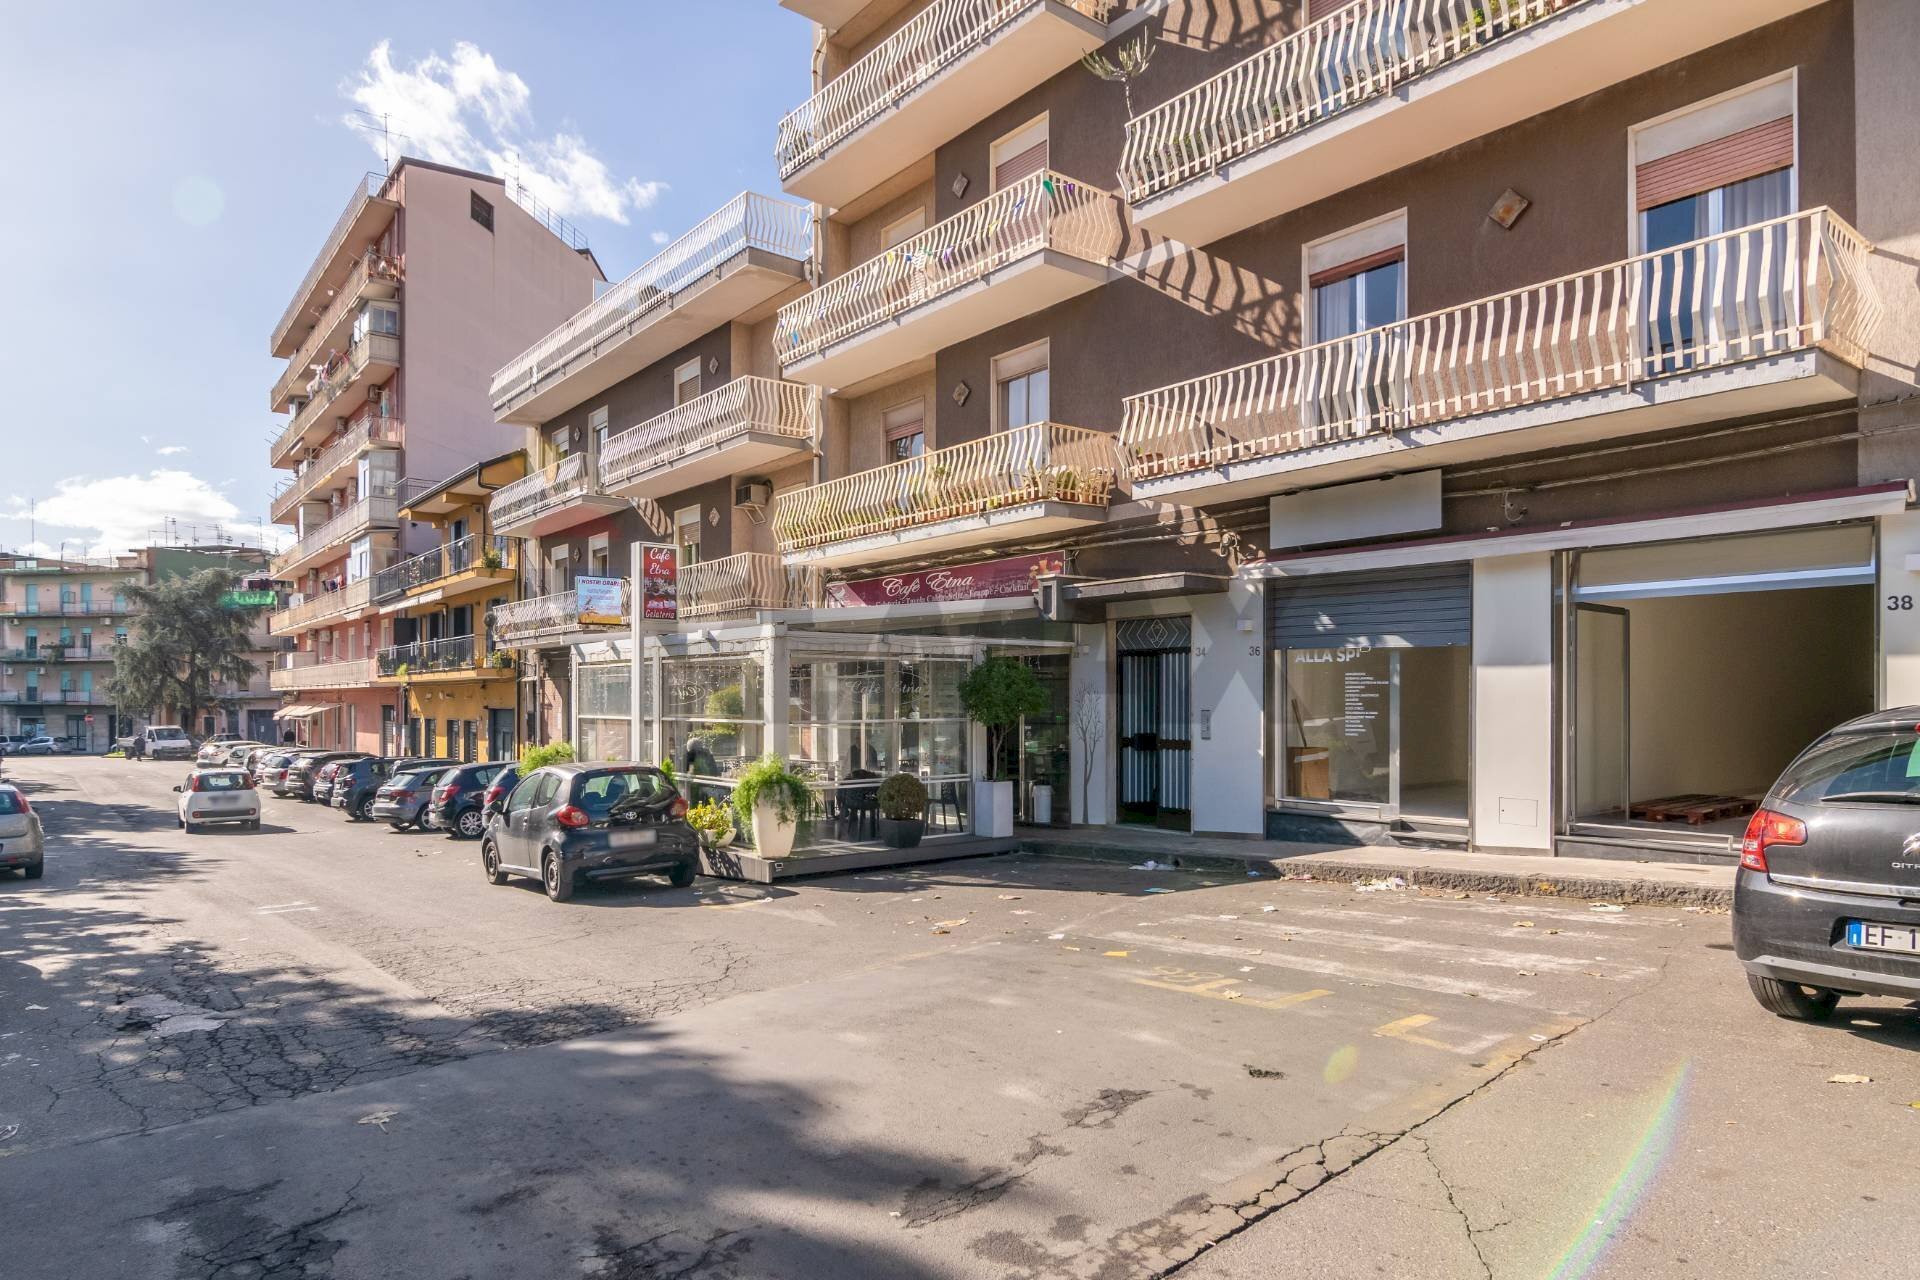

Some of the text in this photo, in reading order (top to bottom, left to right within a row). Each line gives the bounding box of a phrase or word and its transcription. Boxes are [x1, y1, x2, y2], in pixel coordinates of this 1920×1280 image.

[649, 563, 671, 575] Etna
[926, 572, 974, 592] Etna
[1000, 578, 1029, 593] Cocktail
[1887, 595, 1913, 610] 38
[645, 609, 675, 619] Gelateria
[1195, 647, 1206, 656] 34
[1249, 646, 1261, 656] 36
[1295, 648, 1333, 663] ALLA
[1865, 924, 1894, 947] EF
